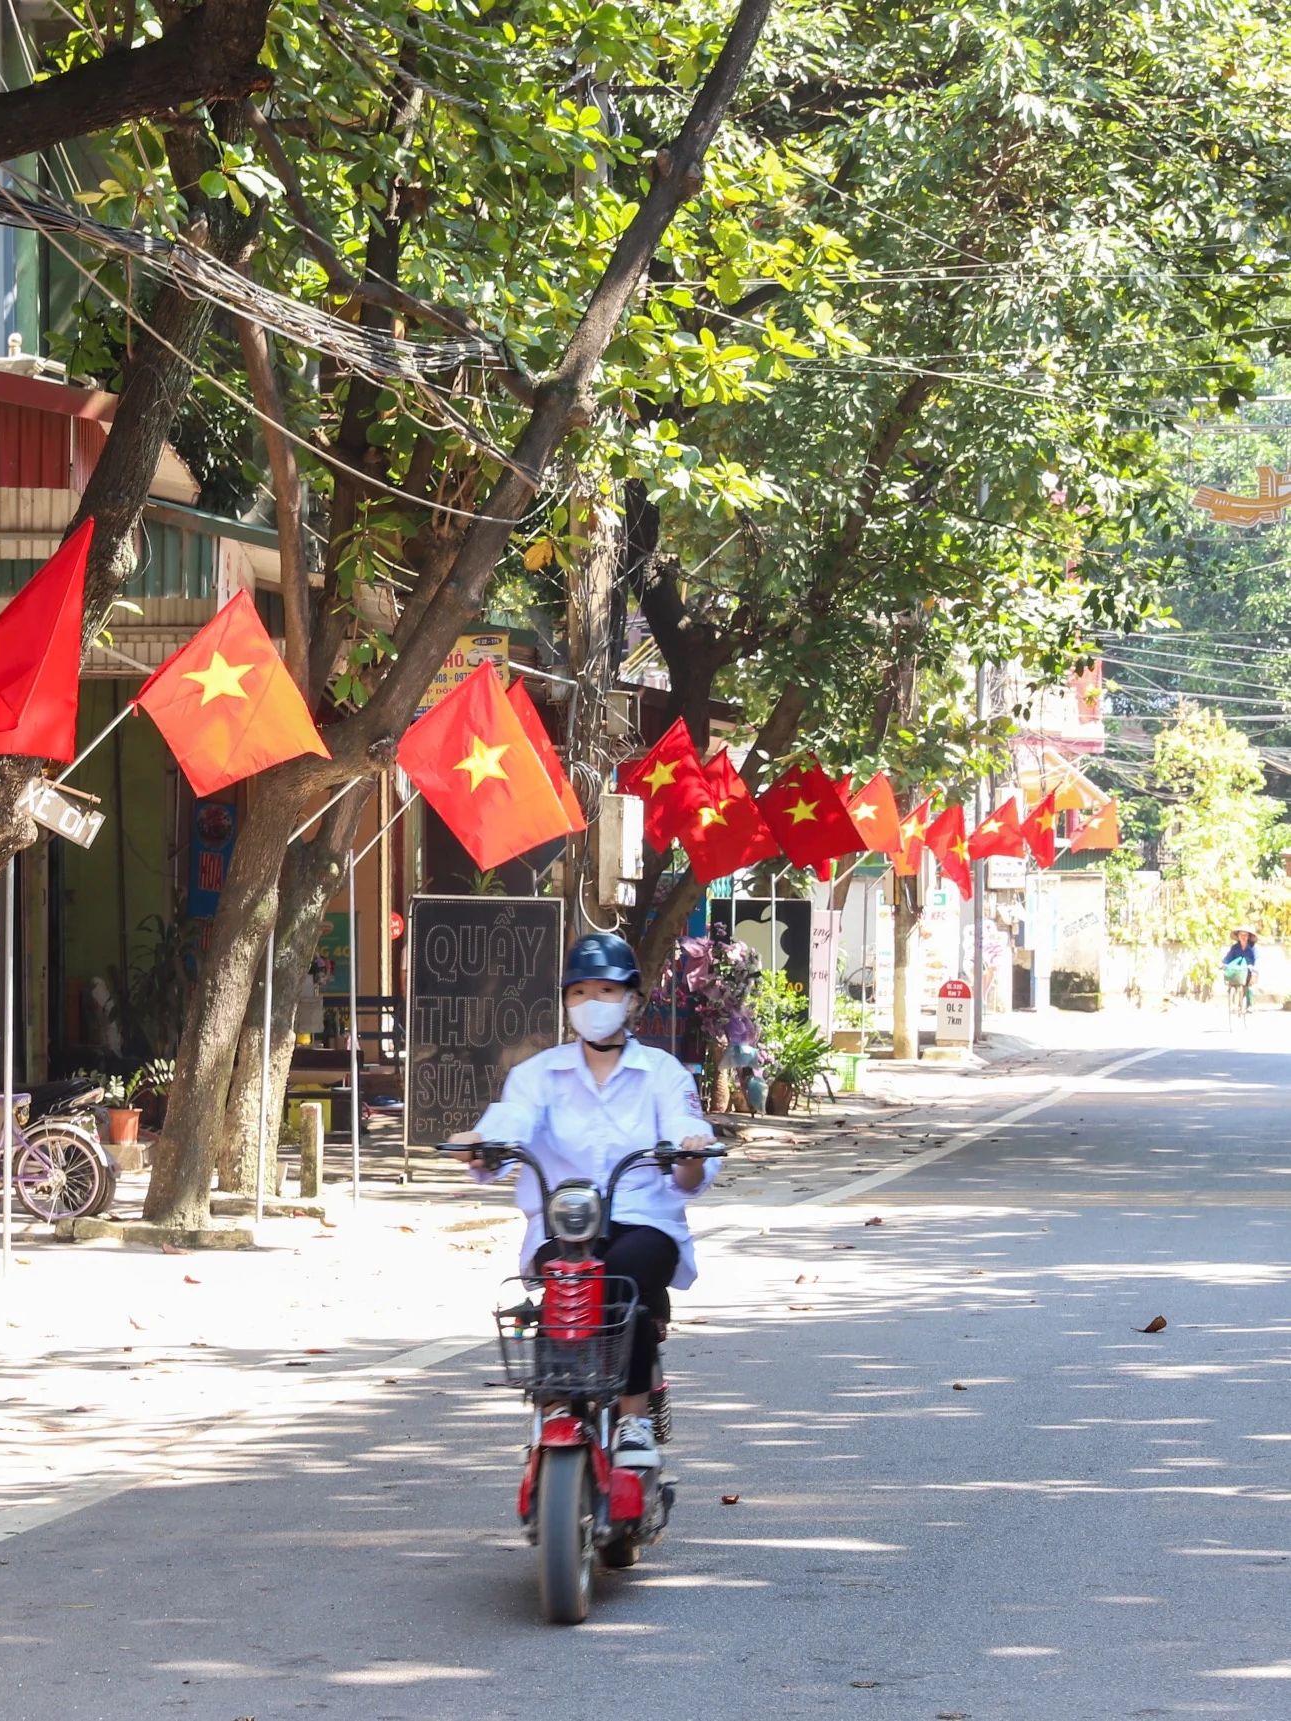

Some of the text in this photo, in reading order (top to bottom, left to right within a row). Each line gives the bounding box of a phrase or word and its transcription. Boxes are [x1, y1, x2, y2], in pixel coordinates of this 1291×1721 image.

[441, 648, 465, 669] HỖ
[18, 780, 60, 822] XE
[425, 906, 546, 983] QUẦY
[416, 978, 555, 1048] THUỐC
[946, 1003, 964, 1014] QL 2
[947, 1016, 962, 1026] 7km
[416, 1052, 479, 1109] SỮA
